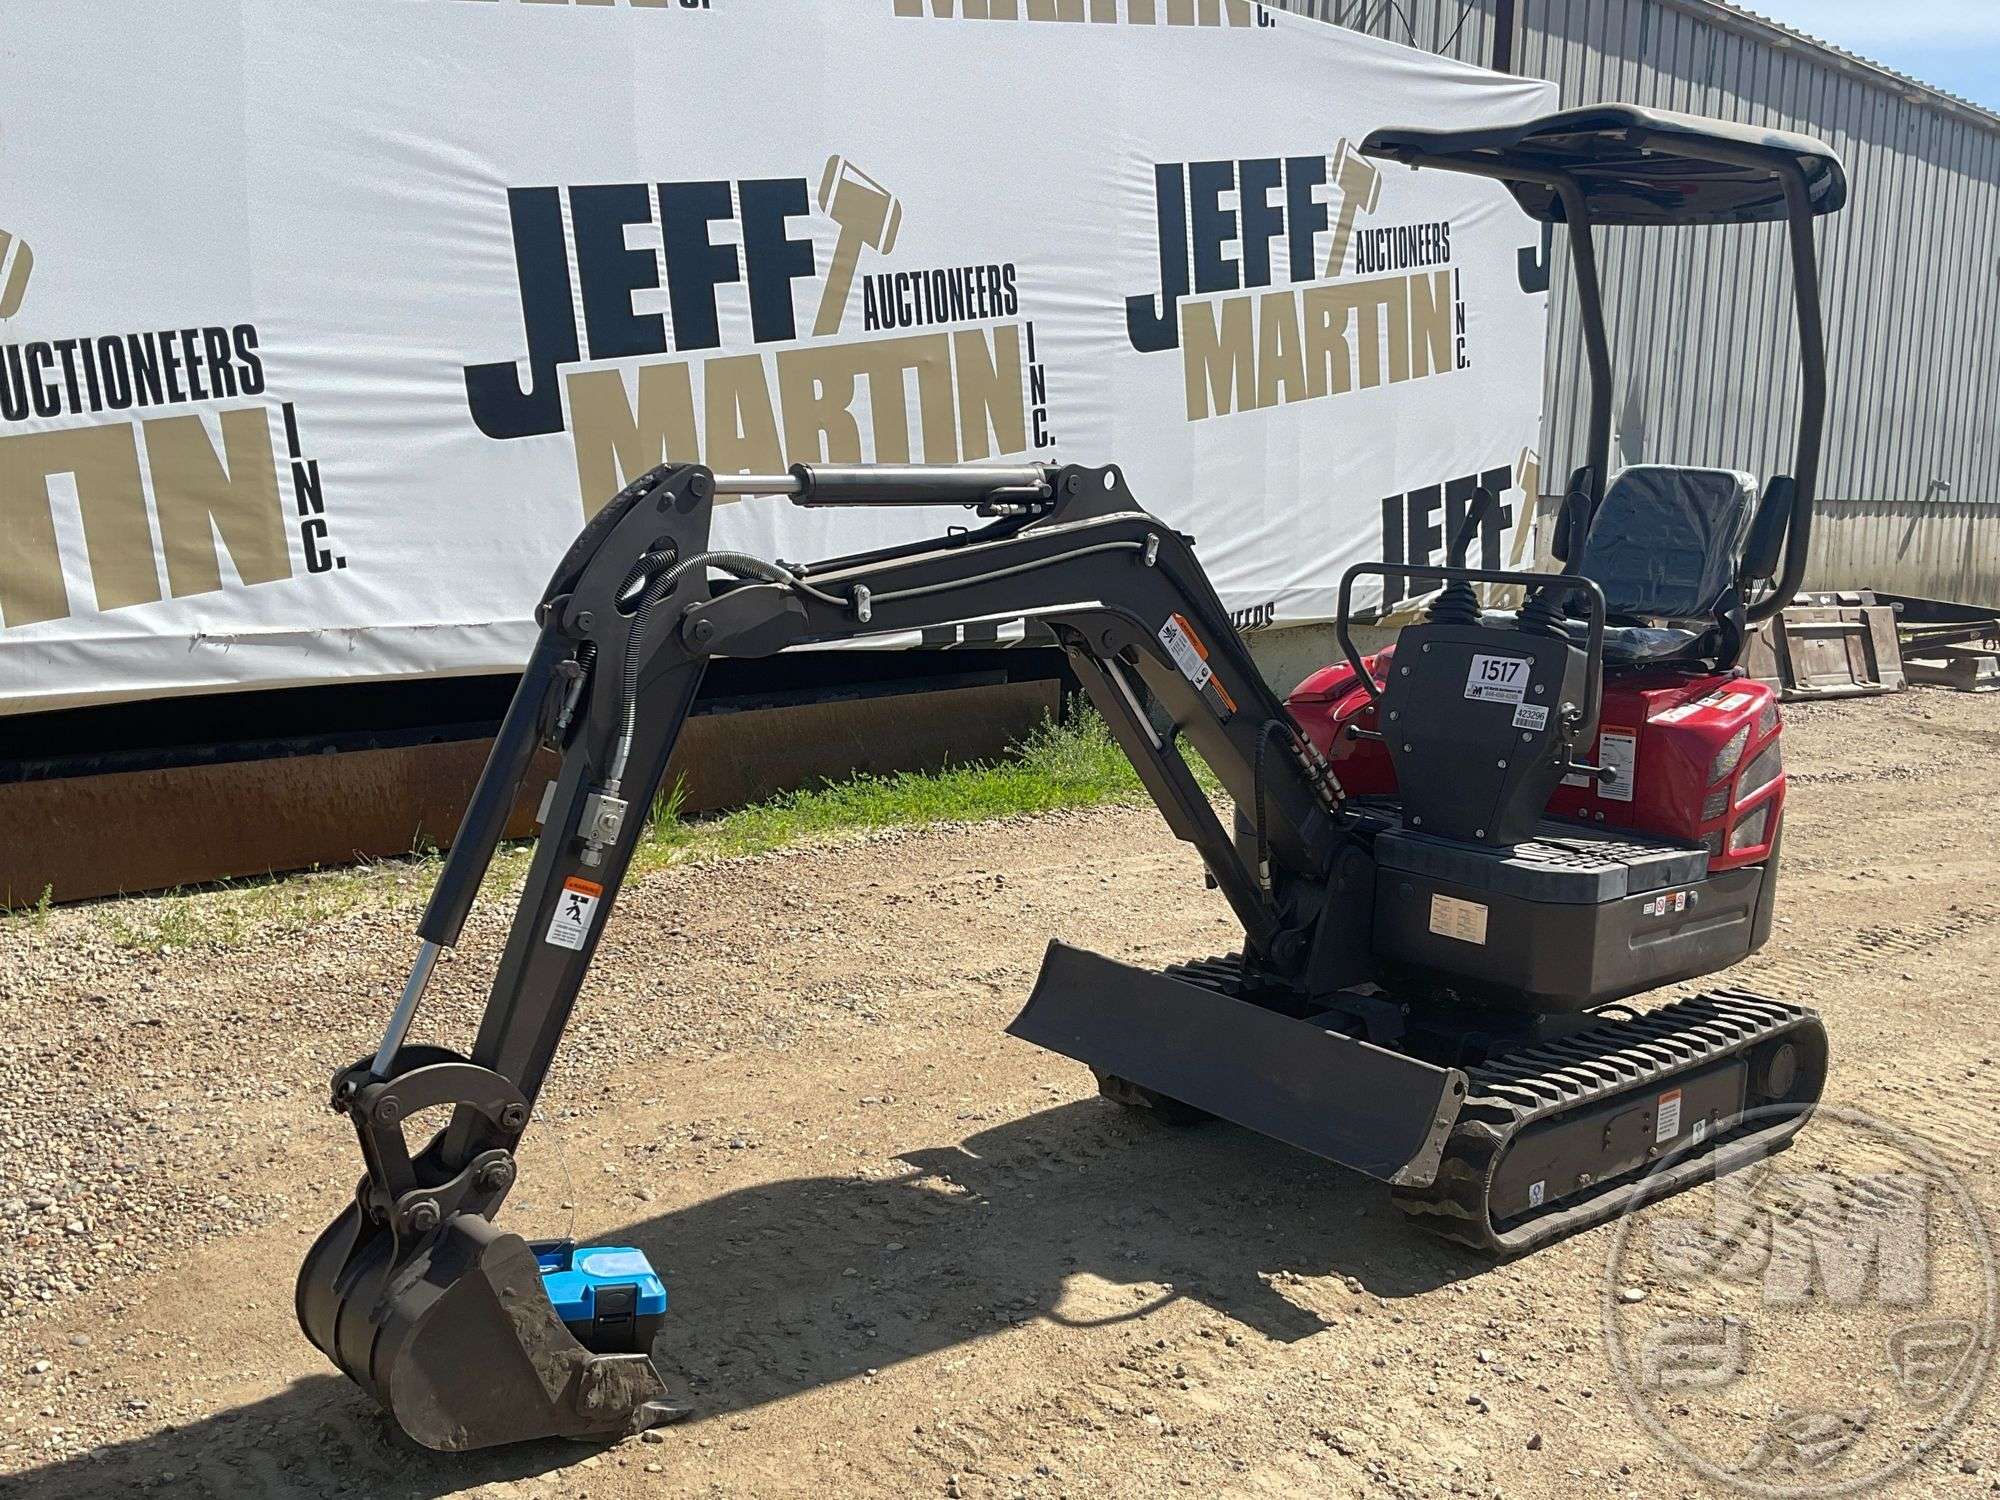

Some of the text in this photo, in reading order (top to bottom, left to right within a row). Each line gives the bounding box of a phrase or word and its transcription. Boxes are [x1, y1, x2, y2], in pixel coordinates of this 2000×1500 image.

[463, 178, 815, 440] JEFF
[863, 263, 1019, 331] AUCTIONEERS
[1125, 156, 1328, 353] JEFF
[1356, 221, 1450, 275] AUCTIONEERS
[1181, 270, 1452, 422] MARTIN
[1454, 267, 1471, 369] INC.
[565, 325, 1027, 526] MARTIN
[1026, 321, 1056, 448] INC.
[281, 402, 347, 574] INC.
[1480, 660, 1520, 682] 1517
[1517, 708, 1545, 721] 423296
